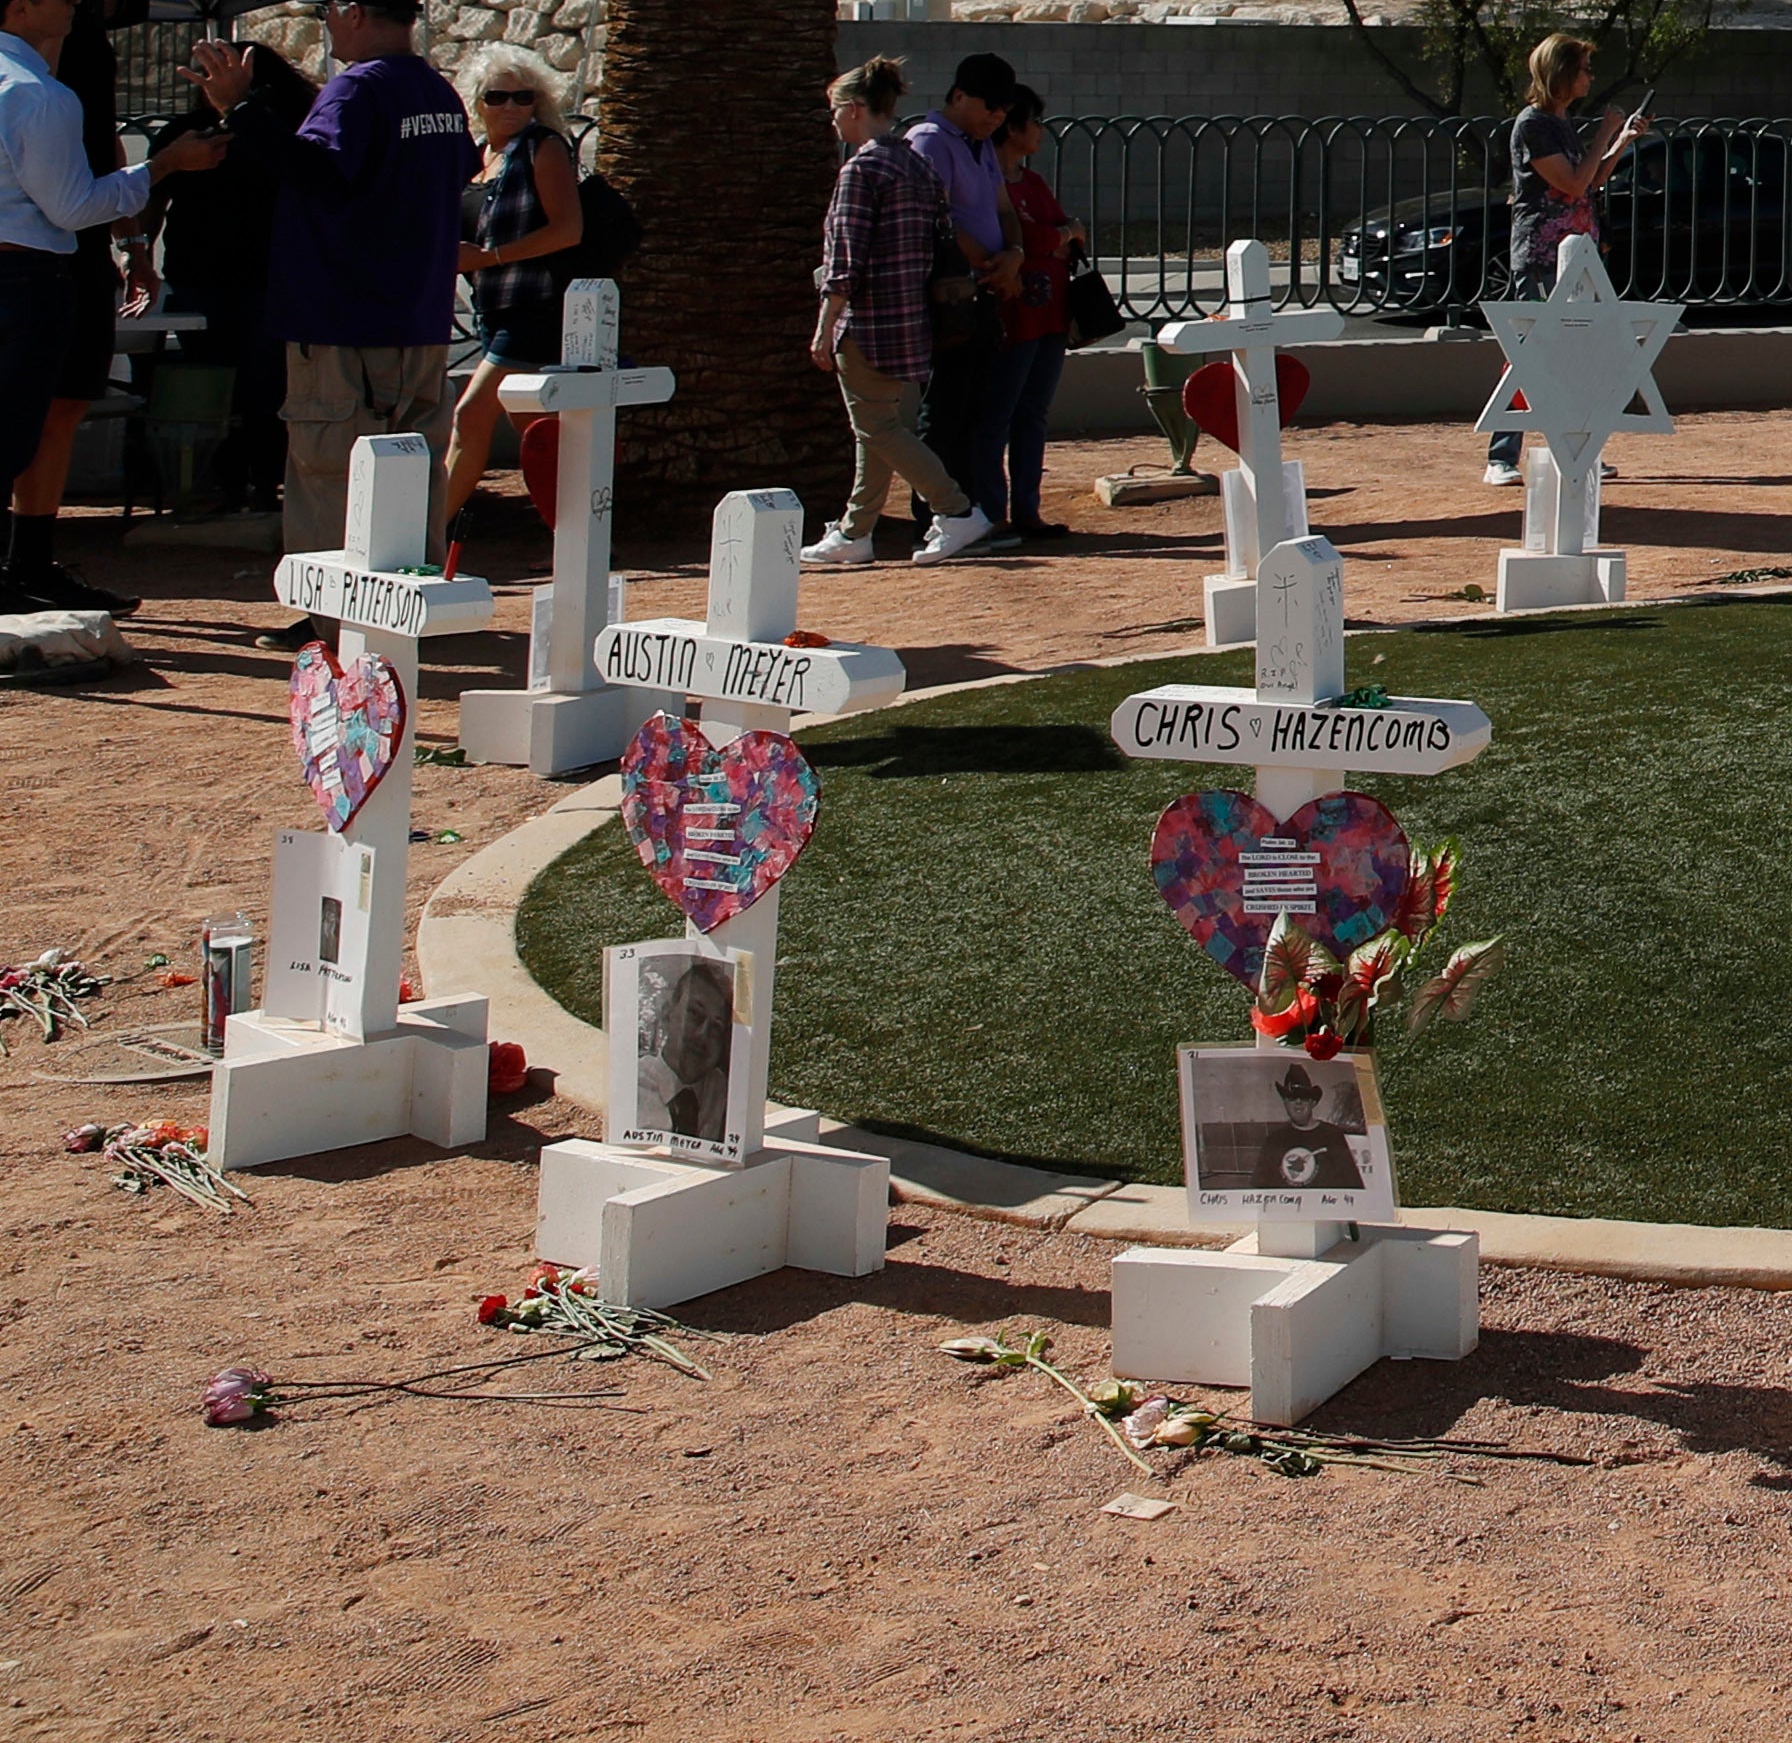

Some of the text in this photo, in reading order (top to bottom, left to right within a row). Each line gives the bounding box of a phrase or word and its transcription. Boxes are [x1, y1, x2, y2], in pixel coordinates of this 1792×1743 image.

[288, 559, 425, 636] LISA PATTERSON
[607, 631, 811, 706] AUSTIN MEYER
[1135, 701, 1451, 753] CHRIS HAZENCOMB
[1247, 869, 1312, 878] BROKEN HEARTED
[619, 948, 635, 960] 33
[289, 960, 312, 972] LISA
[623, 1129, 663, 1144] AUSTIN
[670, 1135, 702, 1151] MEYER
[1200, 1192, 1228, 1205] CHRIS
